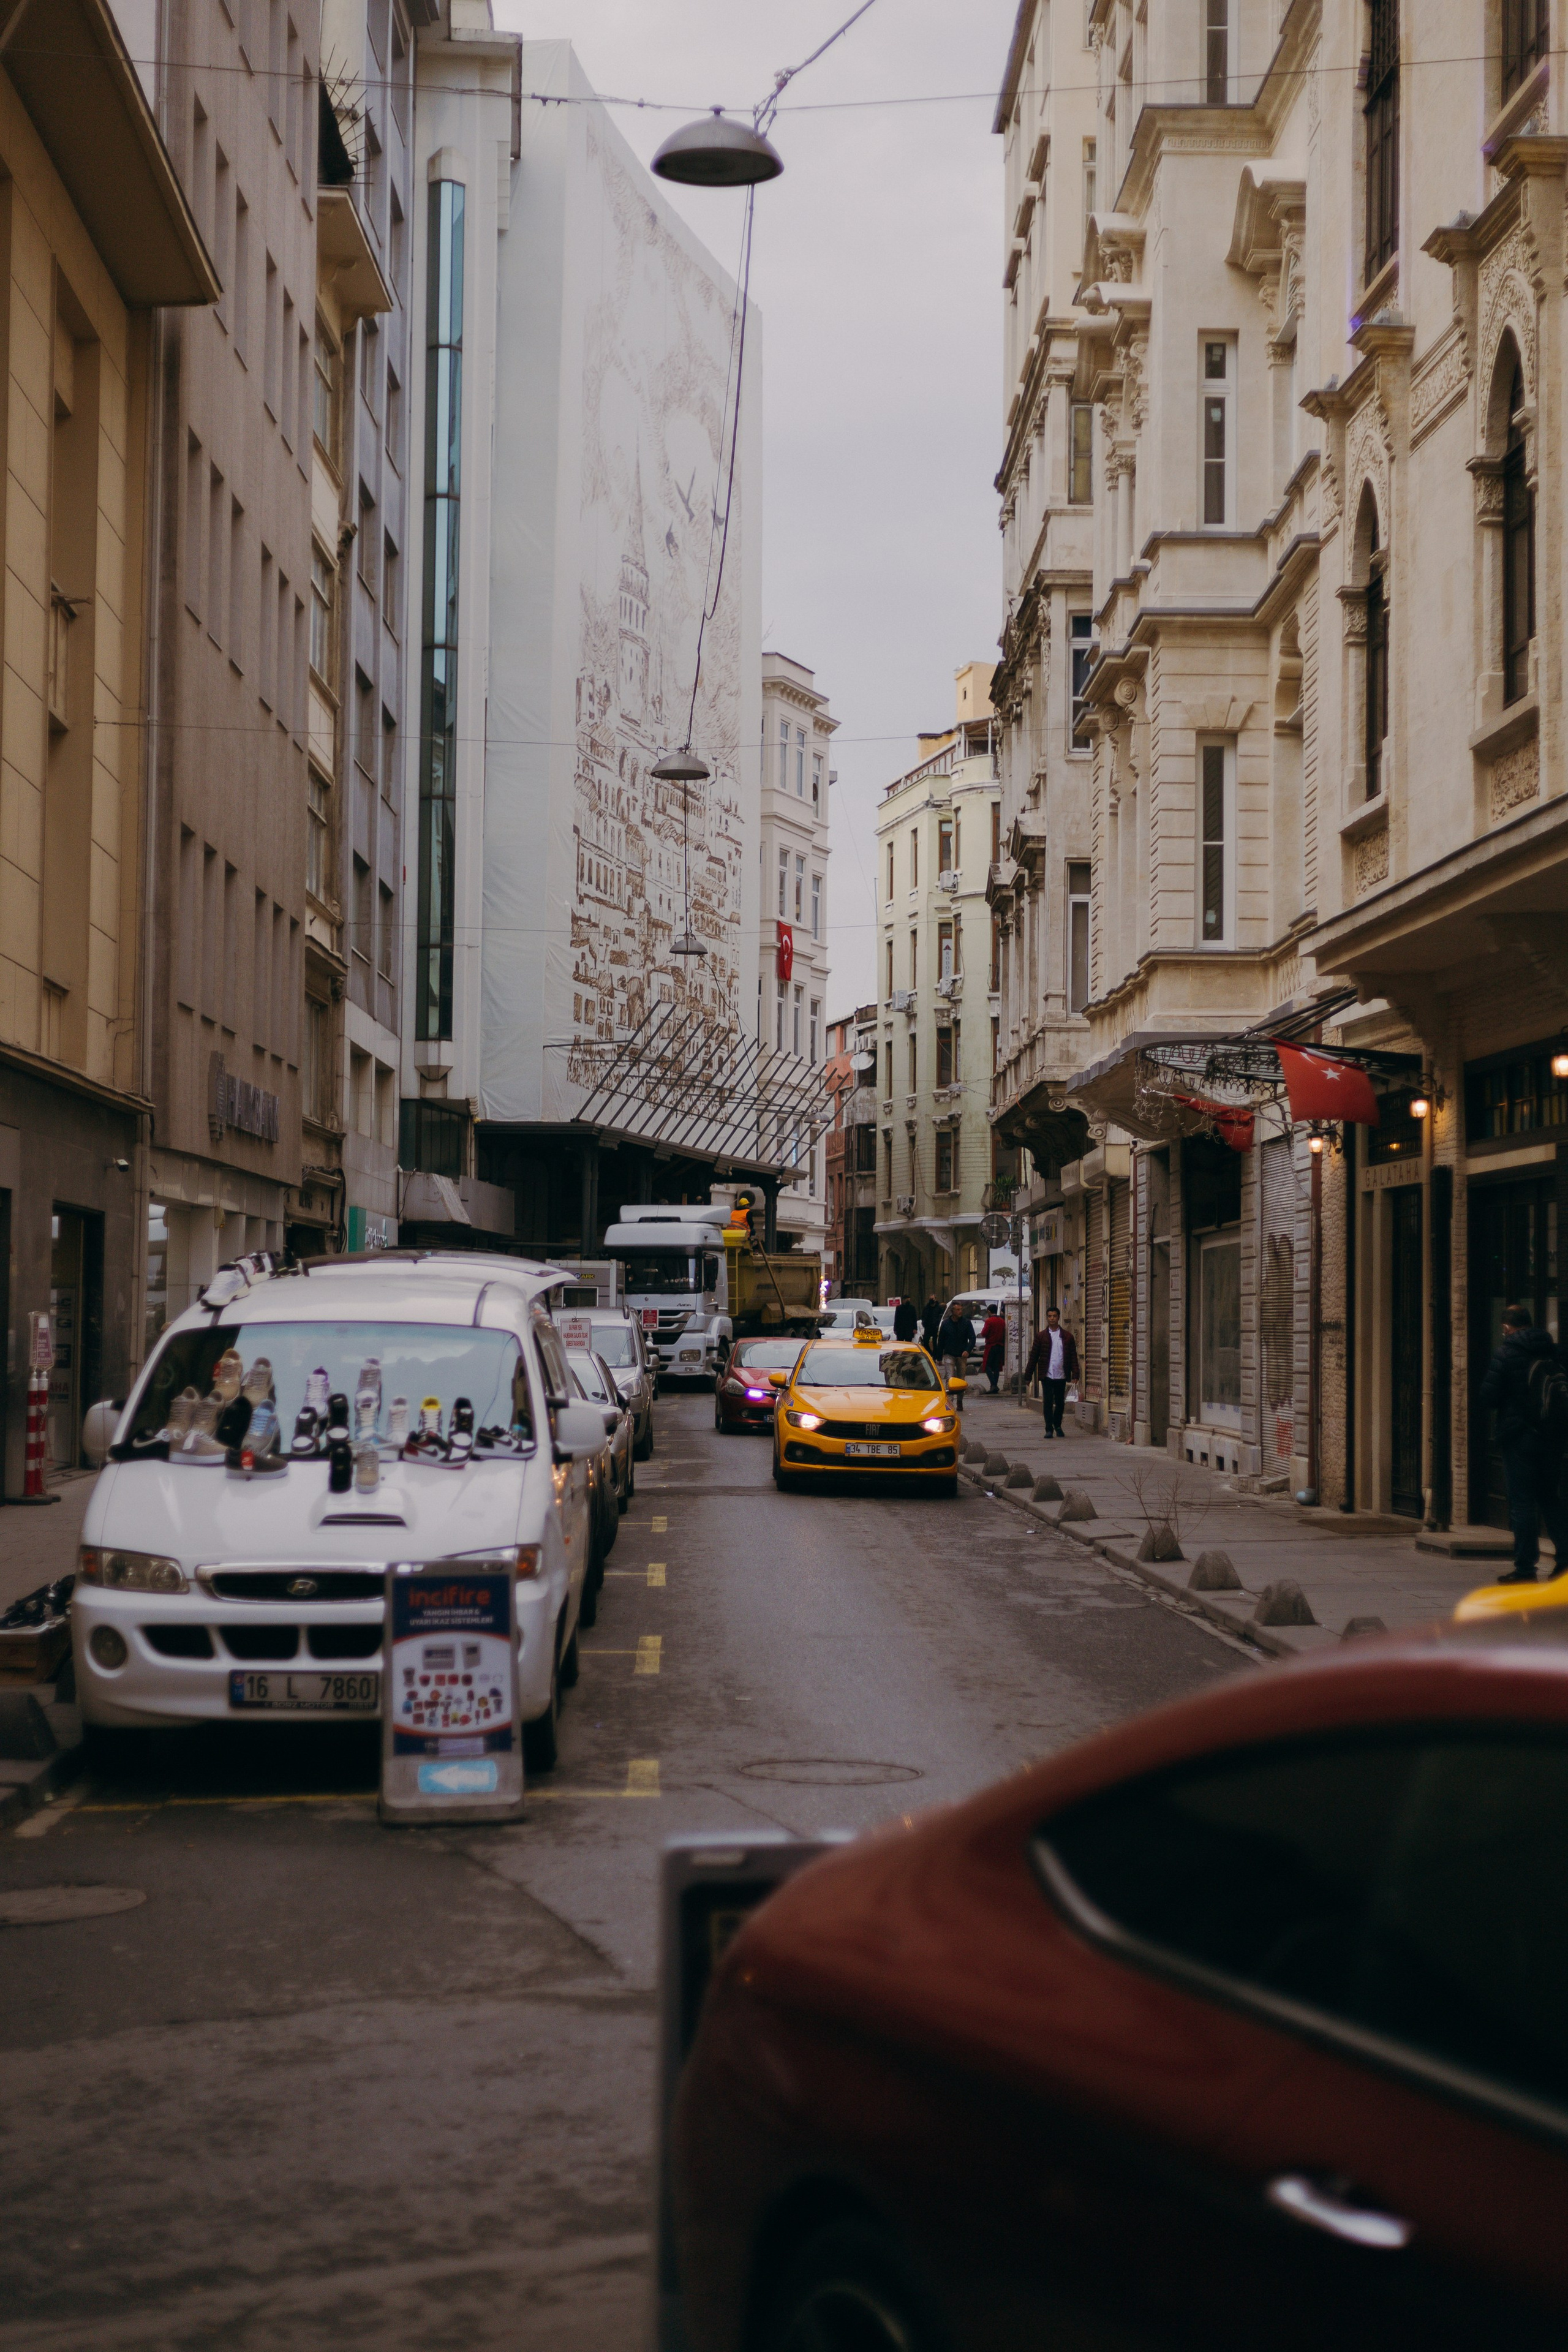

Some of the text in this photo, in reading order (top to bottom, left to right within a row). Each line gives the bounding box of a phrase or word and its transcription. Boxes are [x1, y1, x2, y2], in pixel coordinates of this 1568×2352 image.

[865, 1424, 881, 1435] FIAT
[851, 1444, 861, 1453] 34
[866, 1445, 881, 1453] TBE
[888, 1446, 898, 1454] 85
[408, 1585, 491, 1607] incifire
[247, 1676, 268, 1698] 16
[287, 1676, 298, 1699] L
[320, 1677, 371, 1700] 7860
